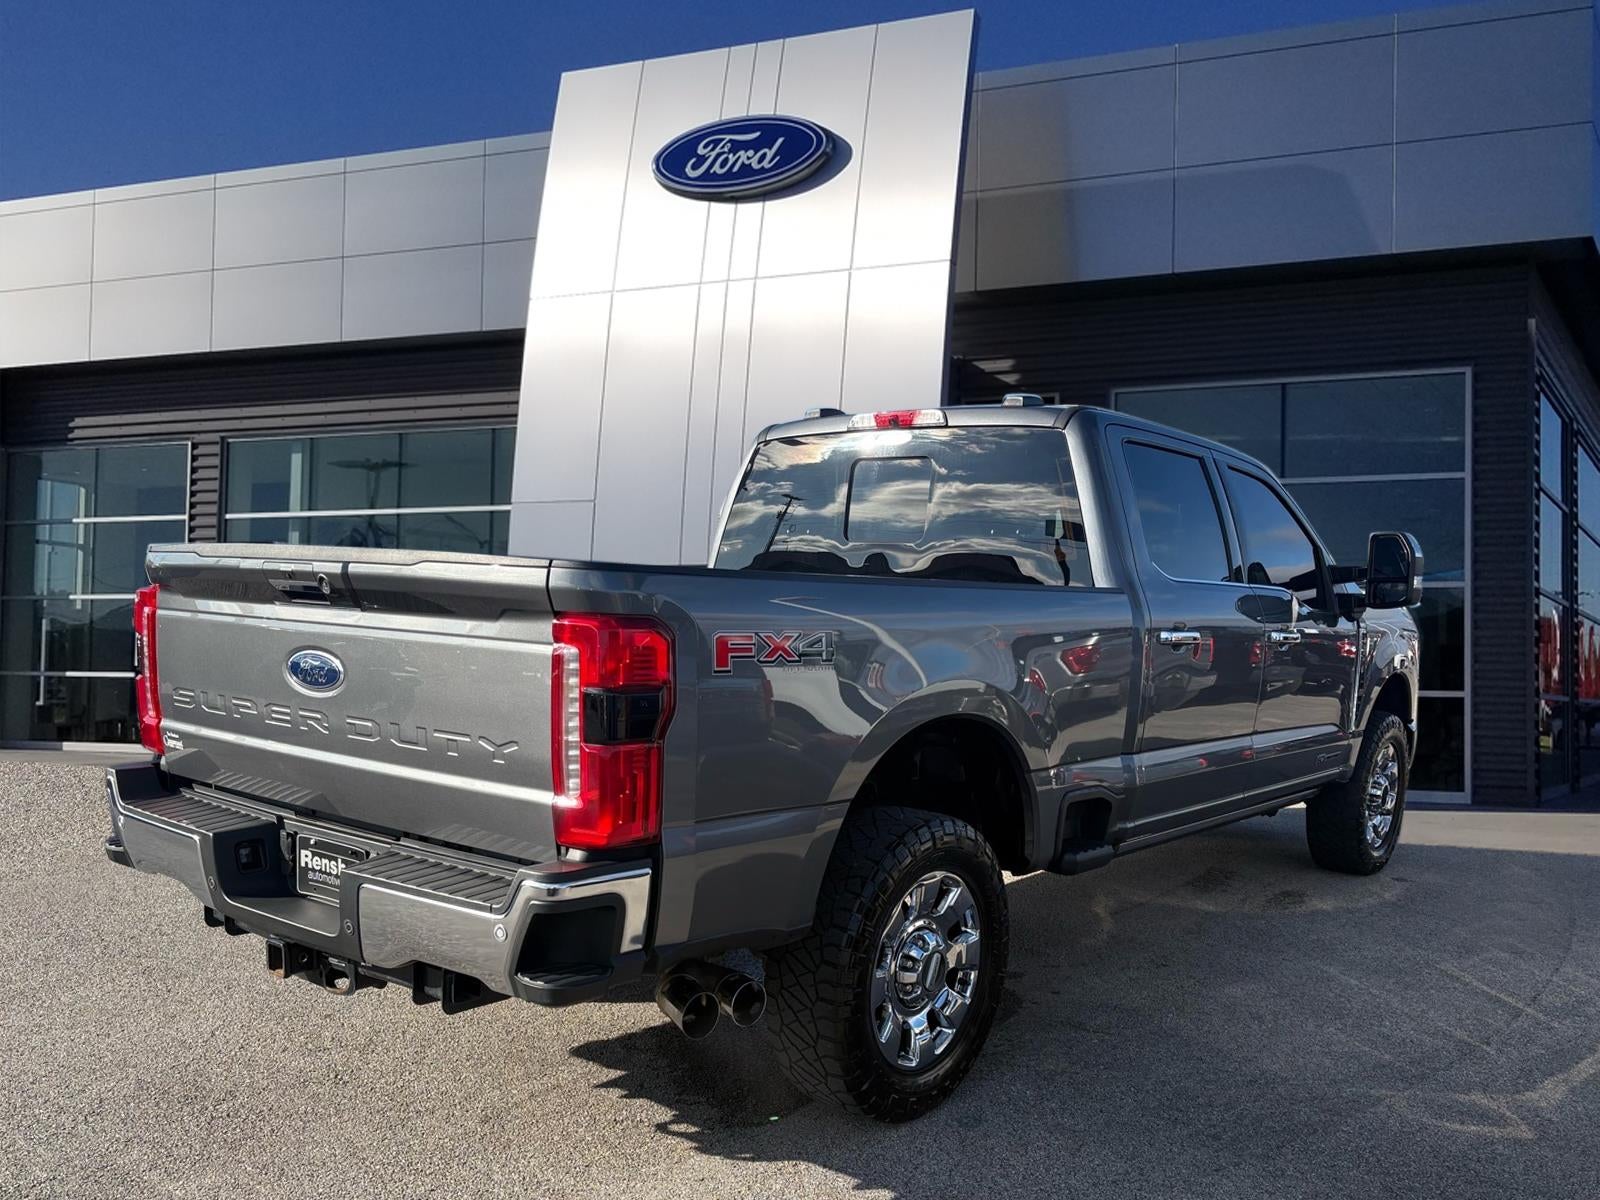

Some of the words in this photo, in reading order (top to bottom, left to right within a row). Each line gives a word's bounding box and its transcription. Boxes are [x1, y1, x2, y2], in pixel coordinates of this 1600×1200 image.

[685, 131, 784, 178] Ford
[298, 658, 328, 683] Ford
[712, 630, 836, 675] FX4
[173, 687, 329, 735] SUPER
[346, 715, 519, 764] DUTY
